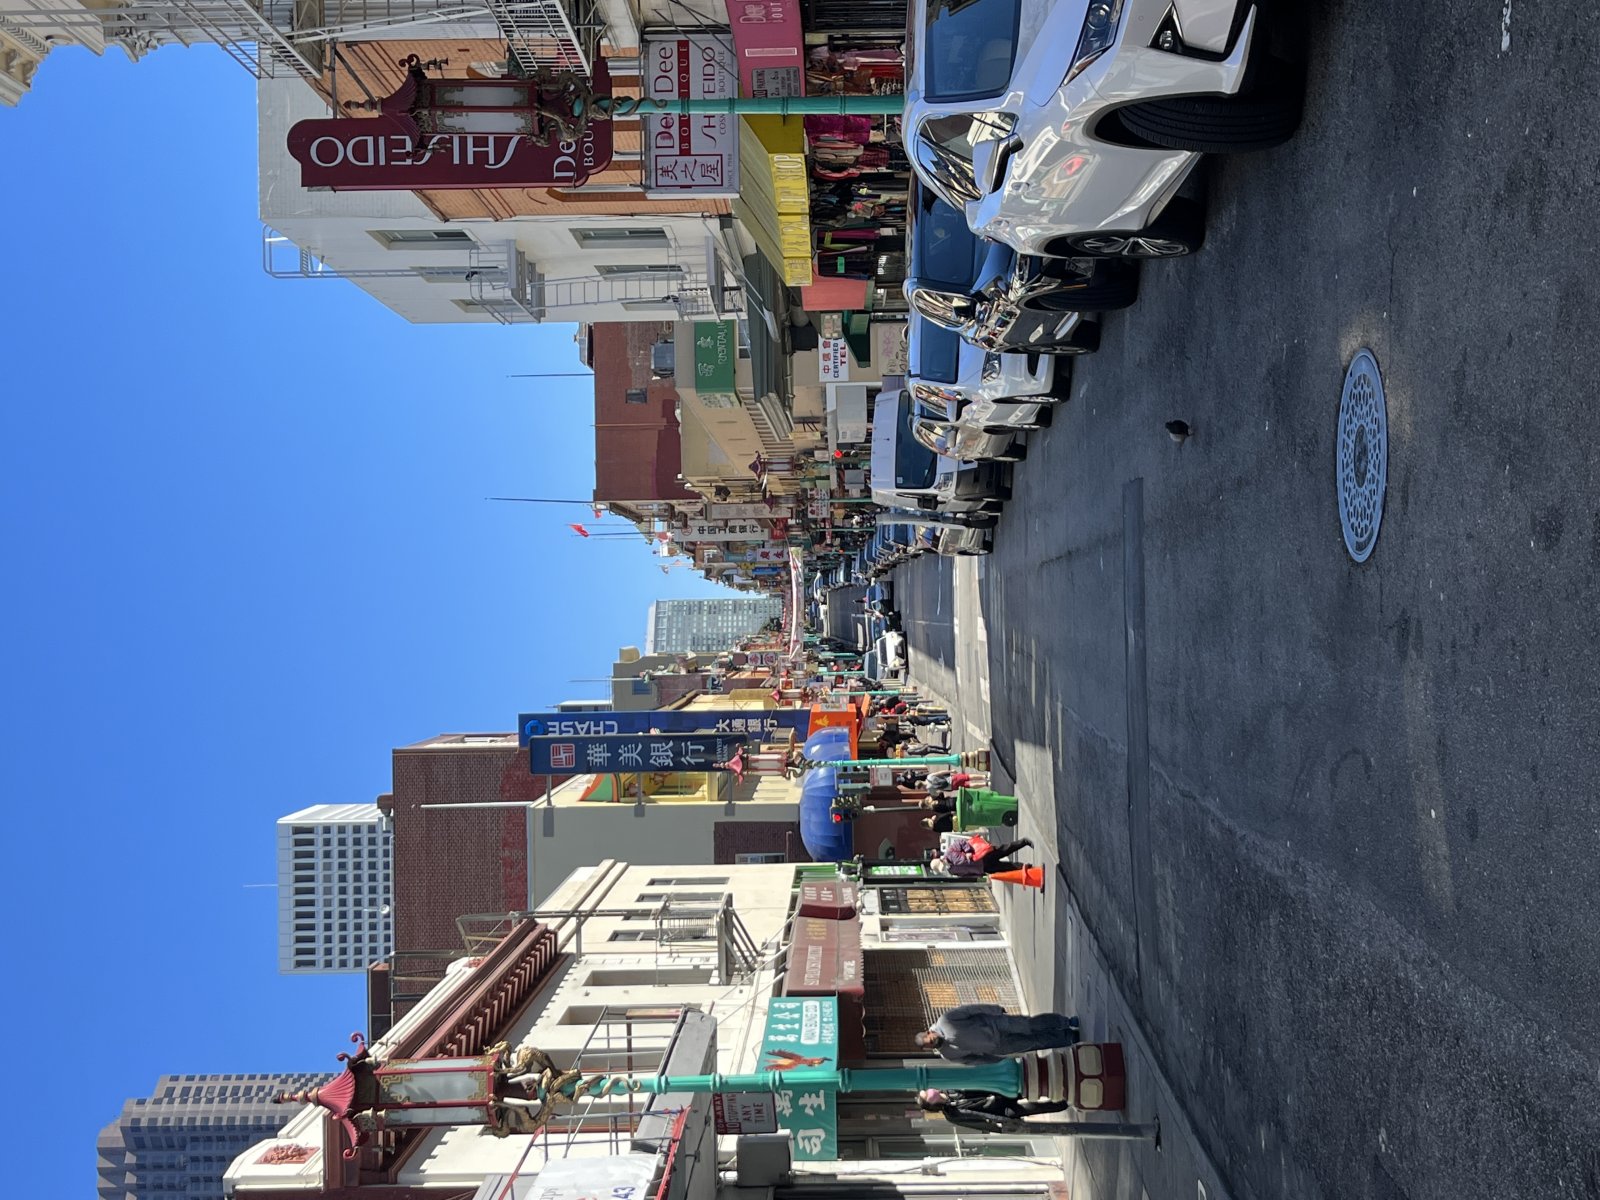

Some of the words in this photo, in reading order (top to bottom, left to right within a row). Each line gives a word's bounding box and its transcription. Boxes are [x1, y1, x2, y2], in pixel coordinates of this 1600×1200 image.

[654, 47, 673, 93] Dee
[717, 50, 727, 93] BOUTIQUE
[680, 46, 690, 149] BOUIQUE
[701, 47, 716, 148] SHEIDO
[655, 113, 674, 149] De
[309, 135, 521, 169] SHISEIDO
[553, 124, 576, 179] De
[658, 159, 719, 181] 美之屋
[773, 154, 805, 181] SHOP
[832, 343, 840, 378] CERTIFIED
[547, 721, 618, 735] CHASE
[715, 719, 777, 733] 大通銀行
[587, 741, 705, 767] 華美銀行
[713, 1095, 726, 1133] TOW-AWAY
[726, 1094, 738, 1121] STOPPING
[741, 1104, 751, 1121] ANY
[753, 1102, 764, 1123] TIME
[727, 1123, 739, 1132] NO
